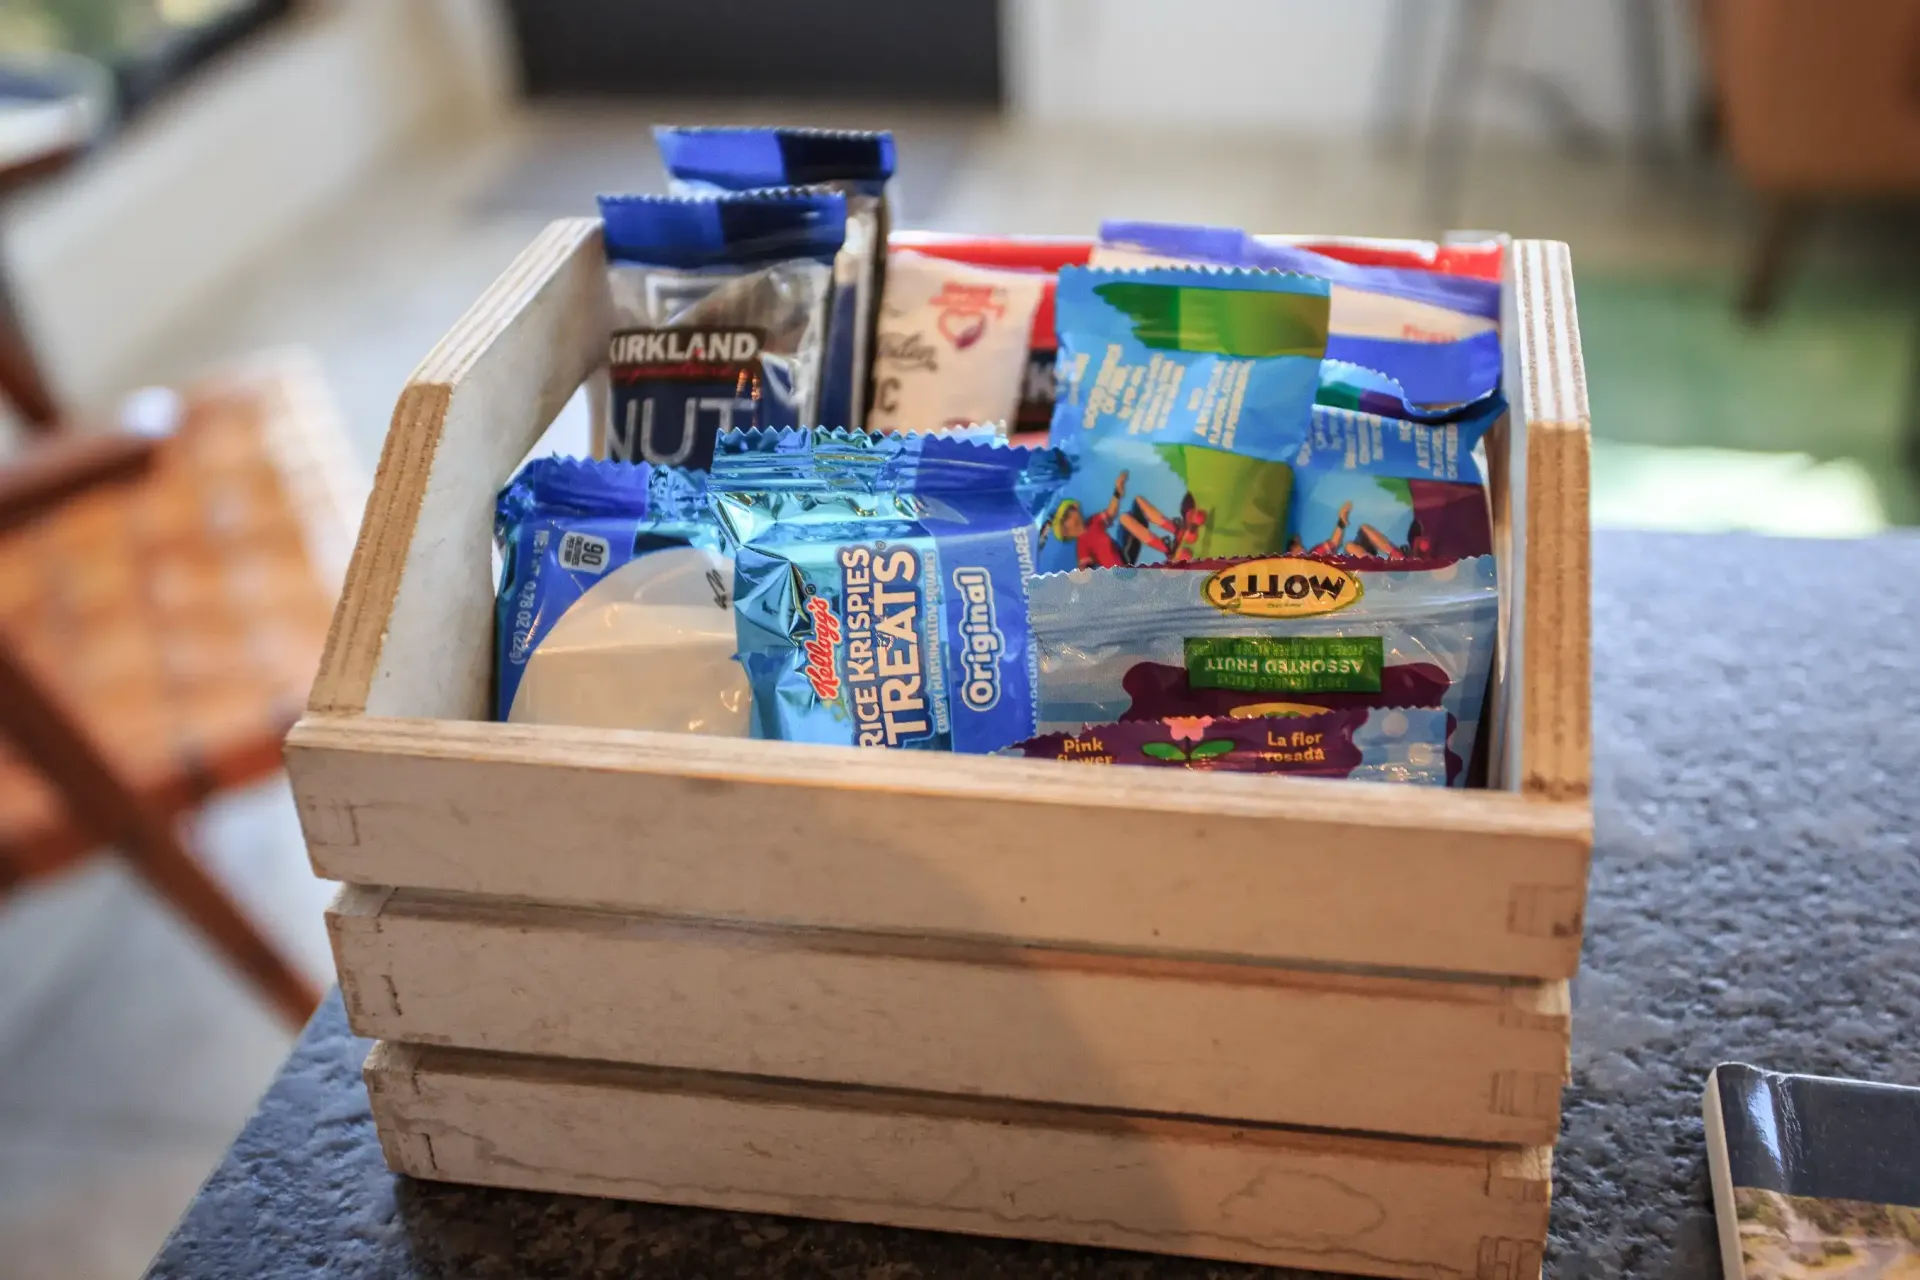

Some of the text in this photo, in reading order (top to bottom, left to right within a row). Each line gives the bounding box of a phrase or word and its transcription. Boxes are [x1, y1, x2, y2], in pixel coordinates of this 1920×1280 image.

[609, 332, 758, 364] KIRKLAND
[581, 541, 604, 566] 90
[803, 597, 841, 700] Kellogg's
[841, 548, 887, 748] RICE KRISPIES
[872, 551, 929, 745] TREATS
[926, 604, 945, 690] MARSHMALLOW
[958, 570, 1001, 707] Original
[1204, 657, 1365, 675] ASSORTED FRUIT
[934, 693, 949, 734] CRISPY
[1063, 736, 1105, 753] Pink
[1262, 746, 1326, 762] rosada
[1267, 730, 1324, 747] La flor
